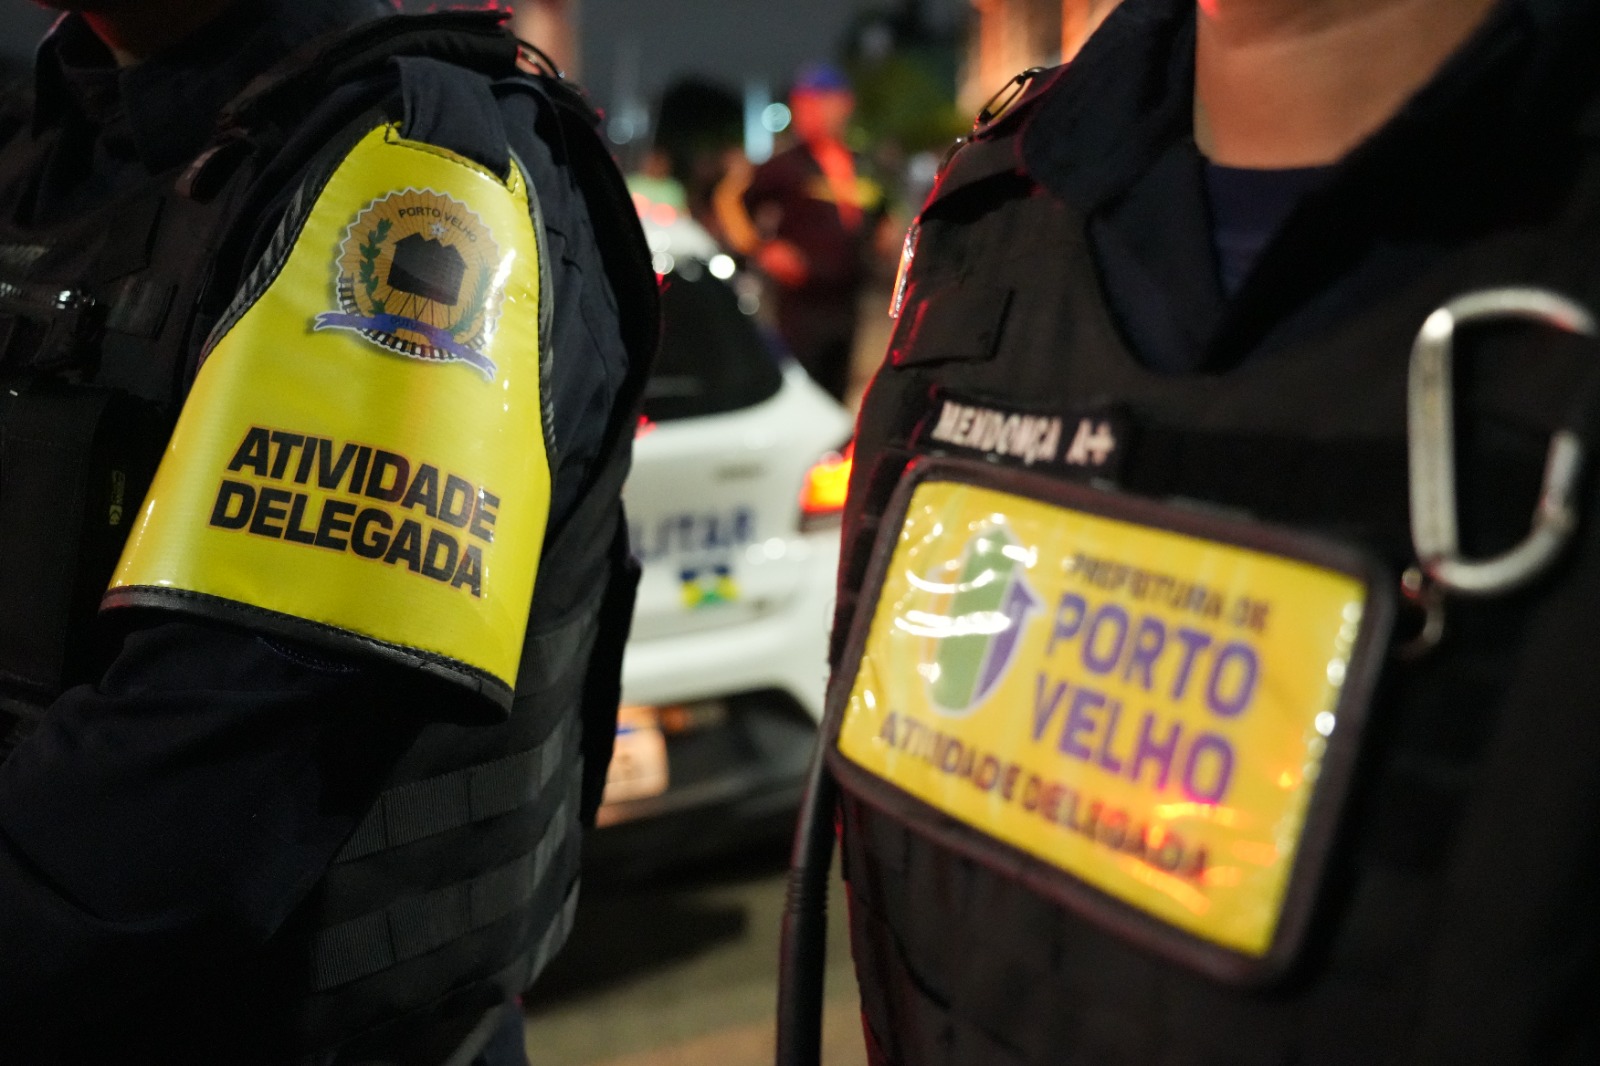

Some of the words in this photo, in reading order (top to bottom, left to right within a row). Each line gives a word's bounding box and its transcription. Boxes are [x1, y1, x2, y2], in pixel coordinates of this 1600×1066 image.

[398, 207, 441, 219] PORTO
[444, 213, 478, 243] VELHO
[226, 426, 500, 544] ATIVIDADE
[931, 399, 1063, 466] MENDONÇA
[1065, 417, 1117, 467] A+
[209, 479, 483, 598] DELEGADA
[1047, 591, 1259, 719] PORTO
[879, 711, 1022, 803] ATIVIDADE
[1033, 671, 1235, 806] VELHO
